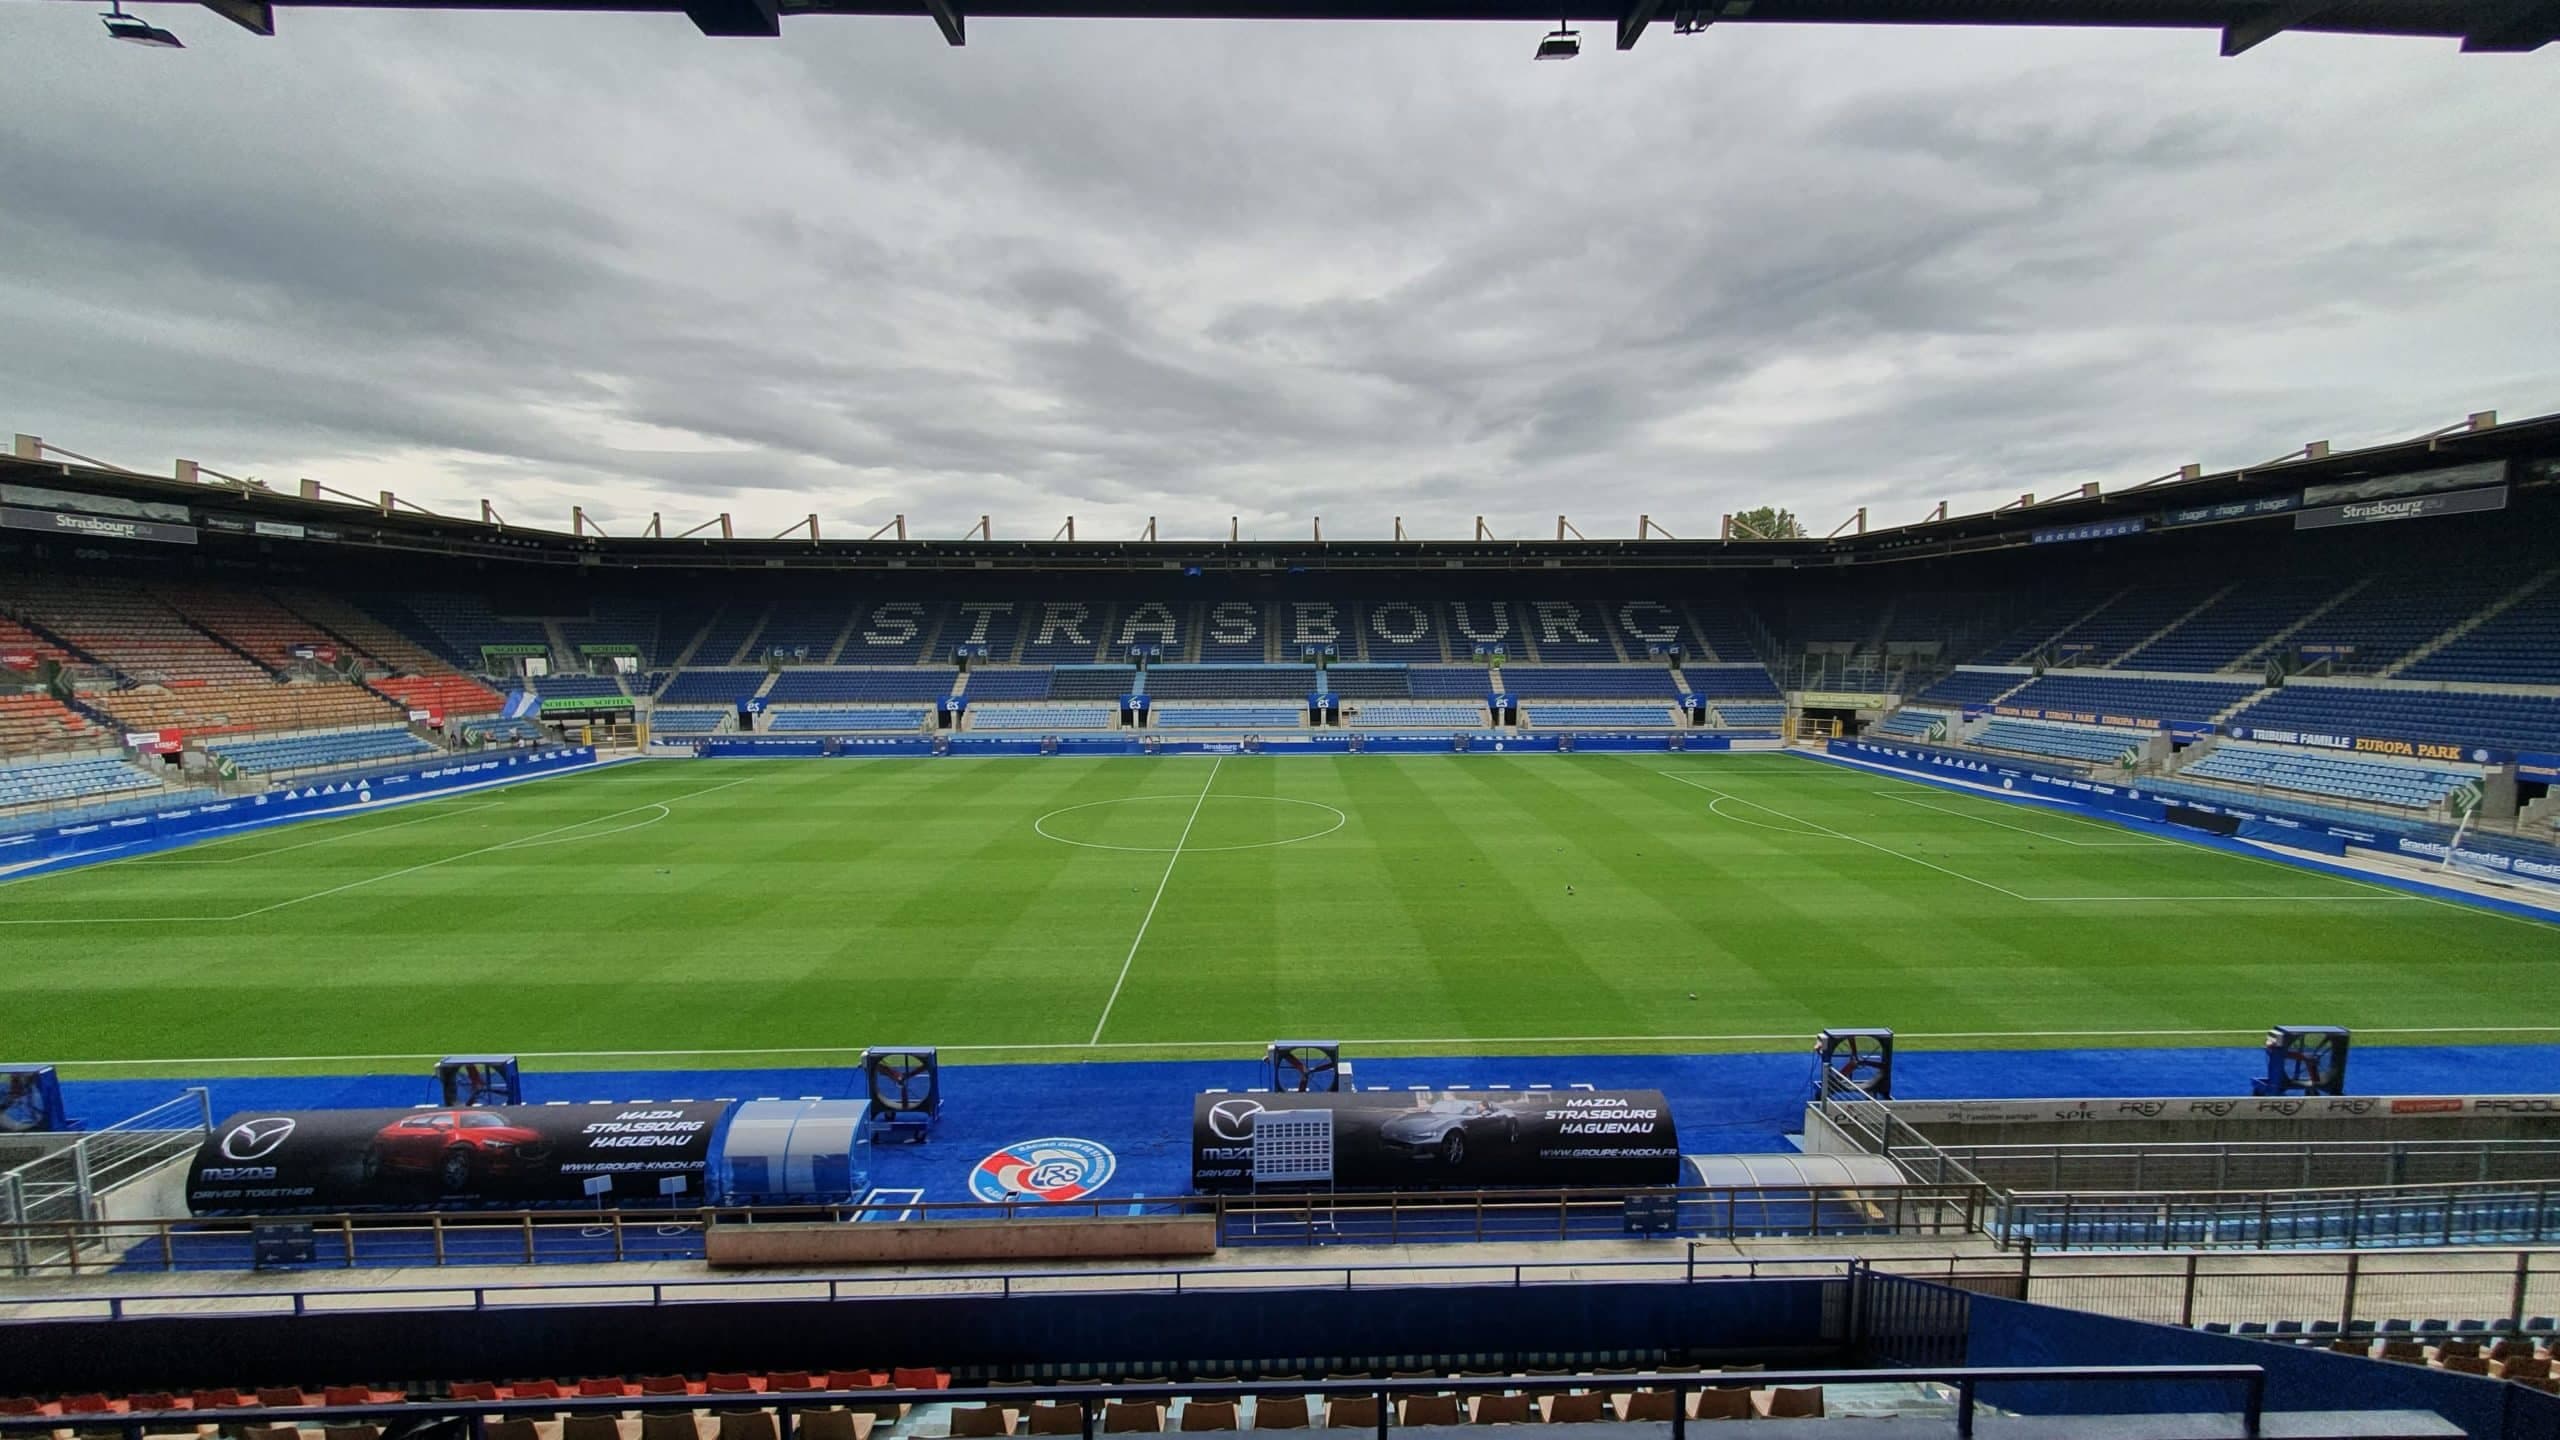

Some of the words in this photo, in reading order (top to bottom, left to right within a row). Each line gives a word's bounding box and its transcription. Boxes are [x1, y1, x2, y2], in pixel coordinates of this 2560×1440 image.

[863, 602, 1682, 644] STRASBOURG
[2252, 729, 2297, 744] TRIBUNE
[2300, 732, 2350, 748] FAMILLE
[2355, 738, 2413, 755] EUROPA
[2417, 744, 2461, 760] PARK
[1566, 1098, 1628, 1107] MAZDA
[616, 1110, 684, 1120] MAZDA
[1545, 1109, 1657, 1120] STRASBOURG
[582, 1121, 705, 1134] STRASBOURG
[1560, 1122, 1654, 1134] HAGUENAU
[589, 1135, 693, 1148] HAGUENAU
[1196, 1169, 1242, 1177] DRIVER
[192, 1189, 240, 1199] DRIVER
[244, 1187, 315, 1198] TOGETHER
